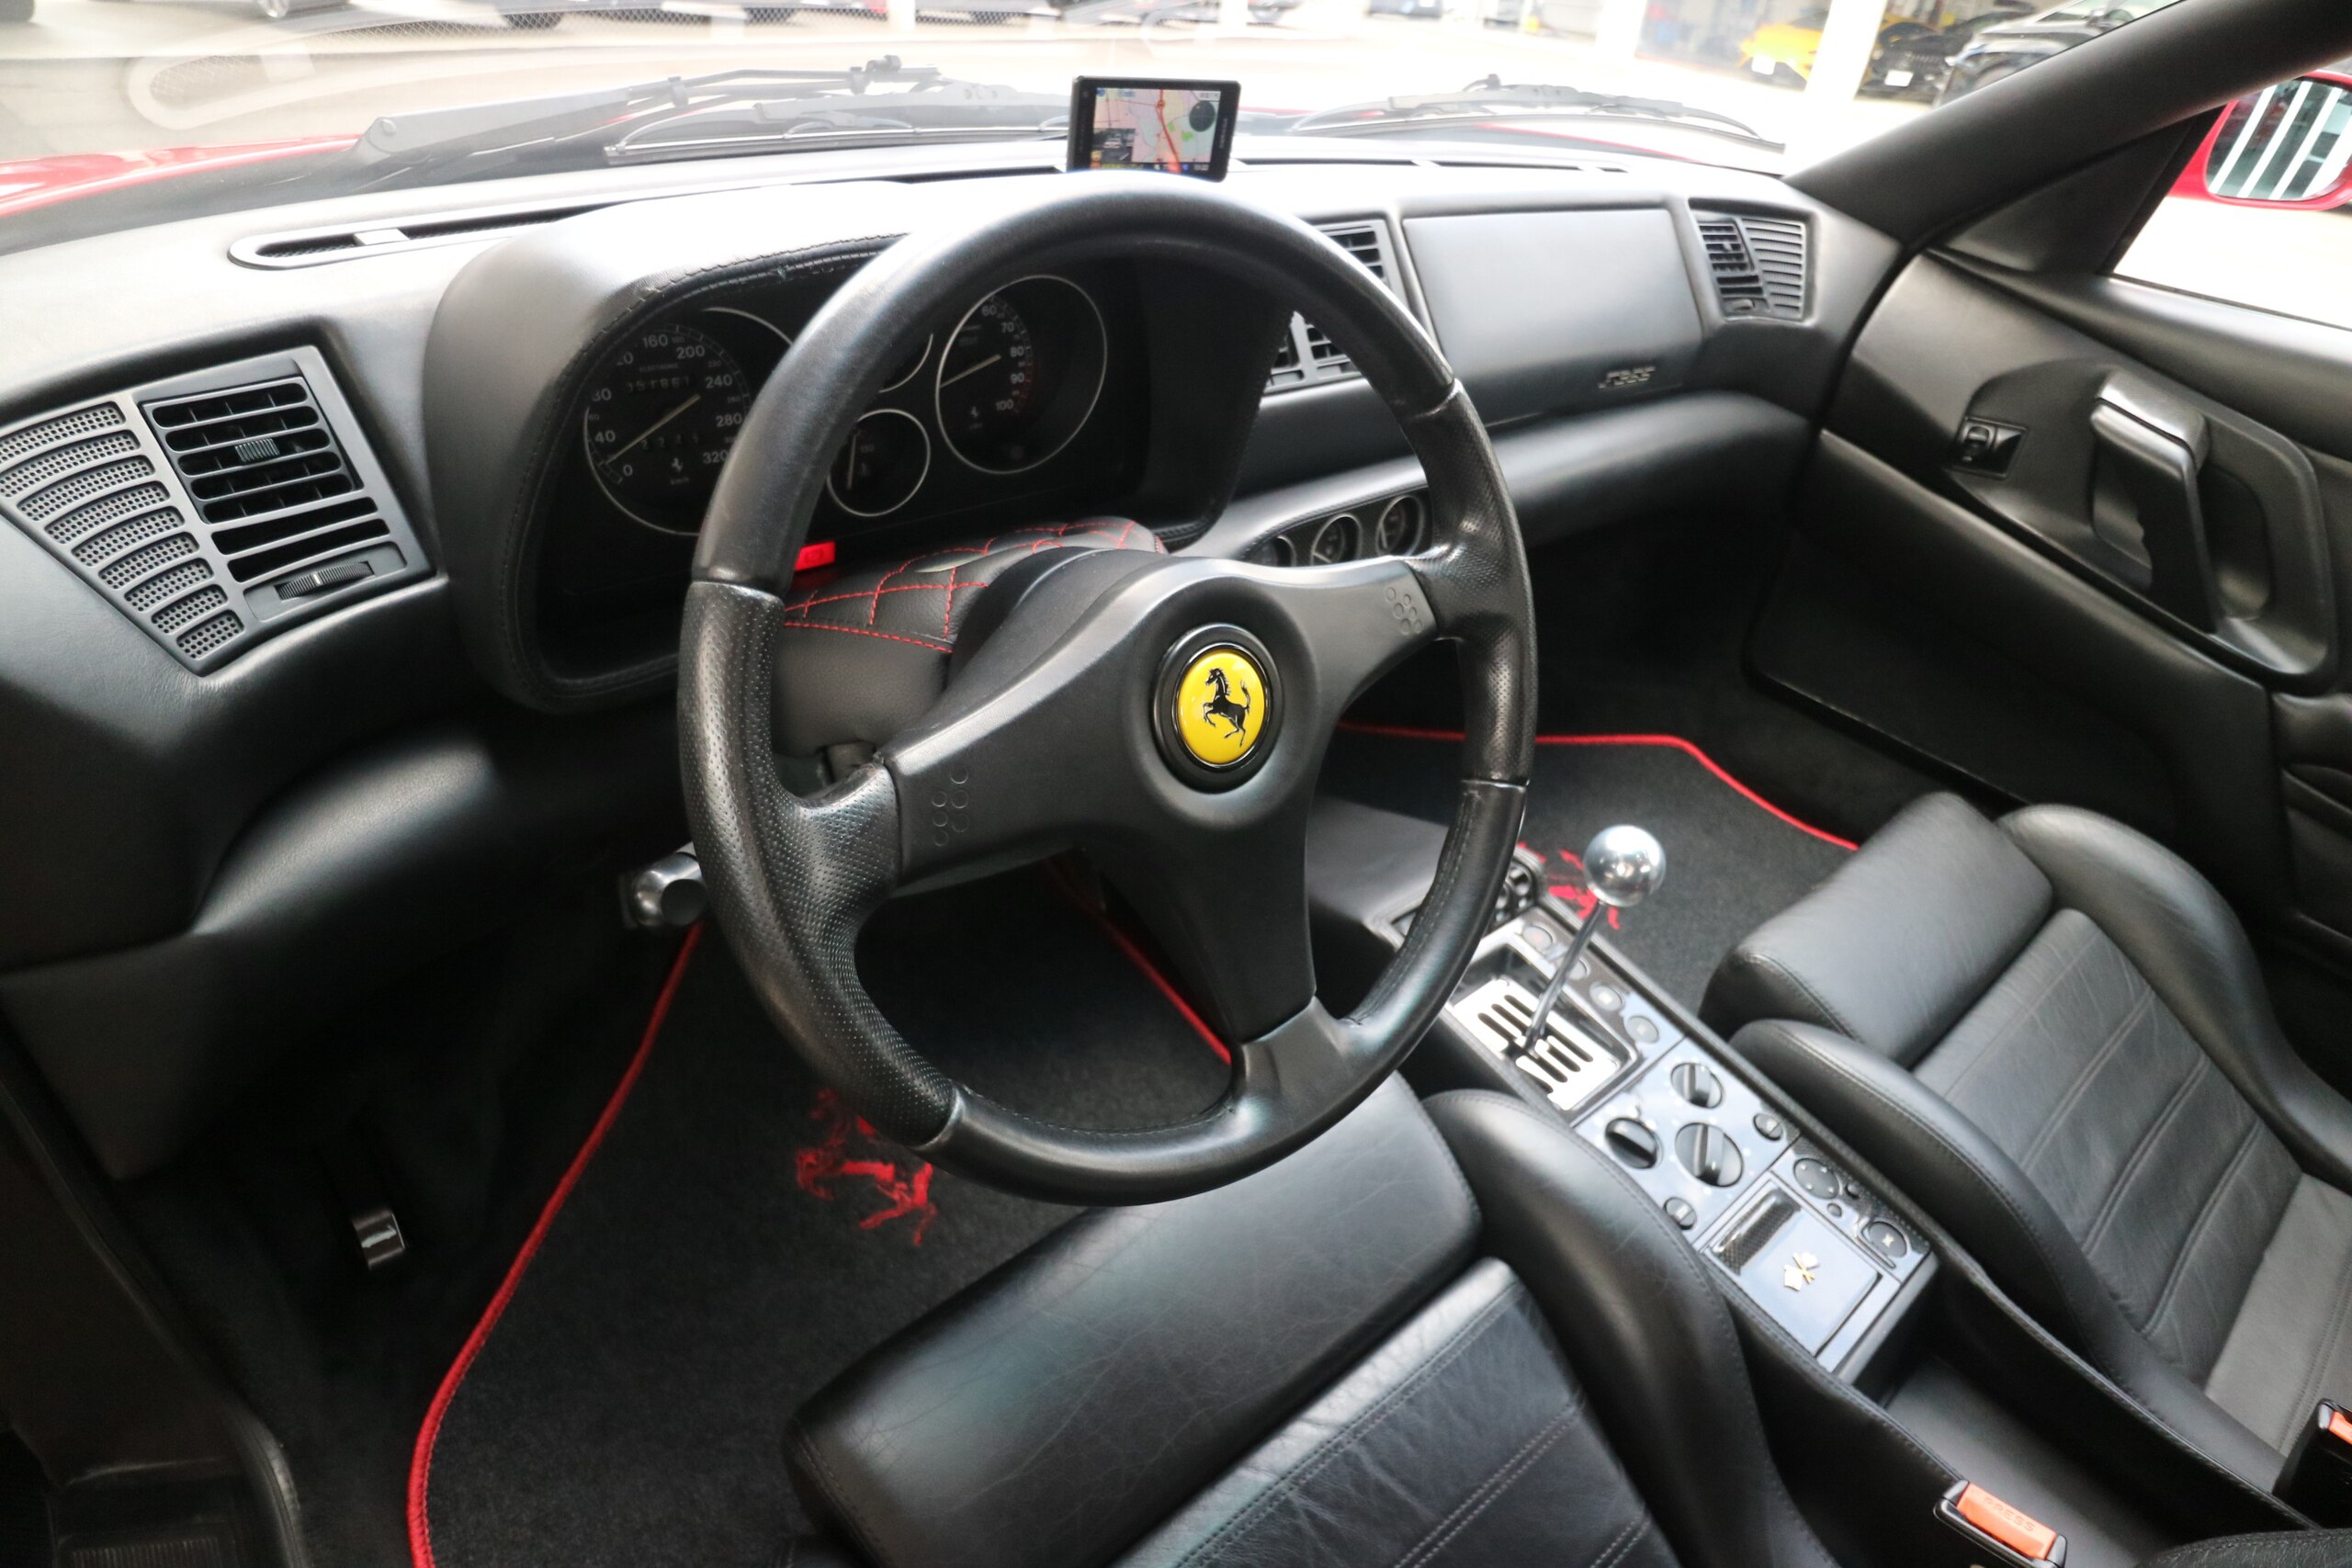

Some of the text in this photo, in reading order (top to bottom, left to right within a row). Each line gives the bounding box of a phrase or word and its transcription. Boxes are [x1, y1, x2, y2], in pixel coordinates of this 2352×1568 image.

[981, 305, 997, 317] 60
[1001, 321, 1014, 333] 70
[642, 333, 668, 348] 160
[676, 344, 706, 360] 200
[1010, 345, 1024, 357] 80
[706, 374, 733, 389] 240
[1010, 373, 1024, 384] 90
[995, 400, 1014, 412] 100
[715, 412, 743, 428] 280
[594, 429, 616, 444] 40
[702, 450, 729, 465] 320
[622, 464, 634, 477] 0
[1983, 1495, 2036, 1533] PRESS
